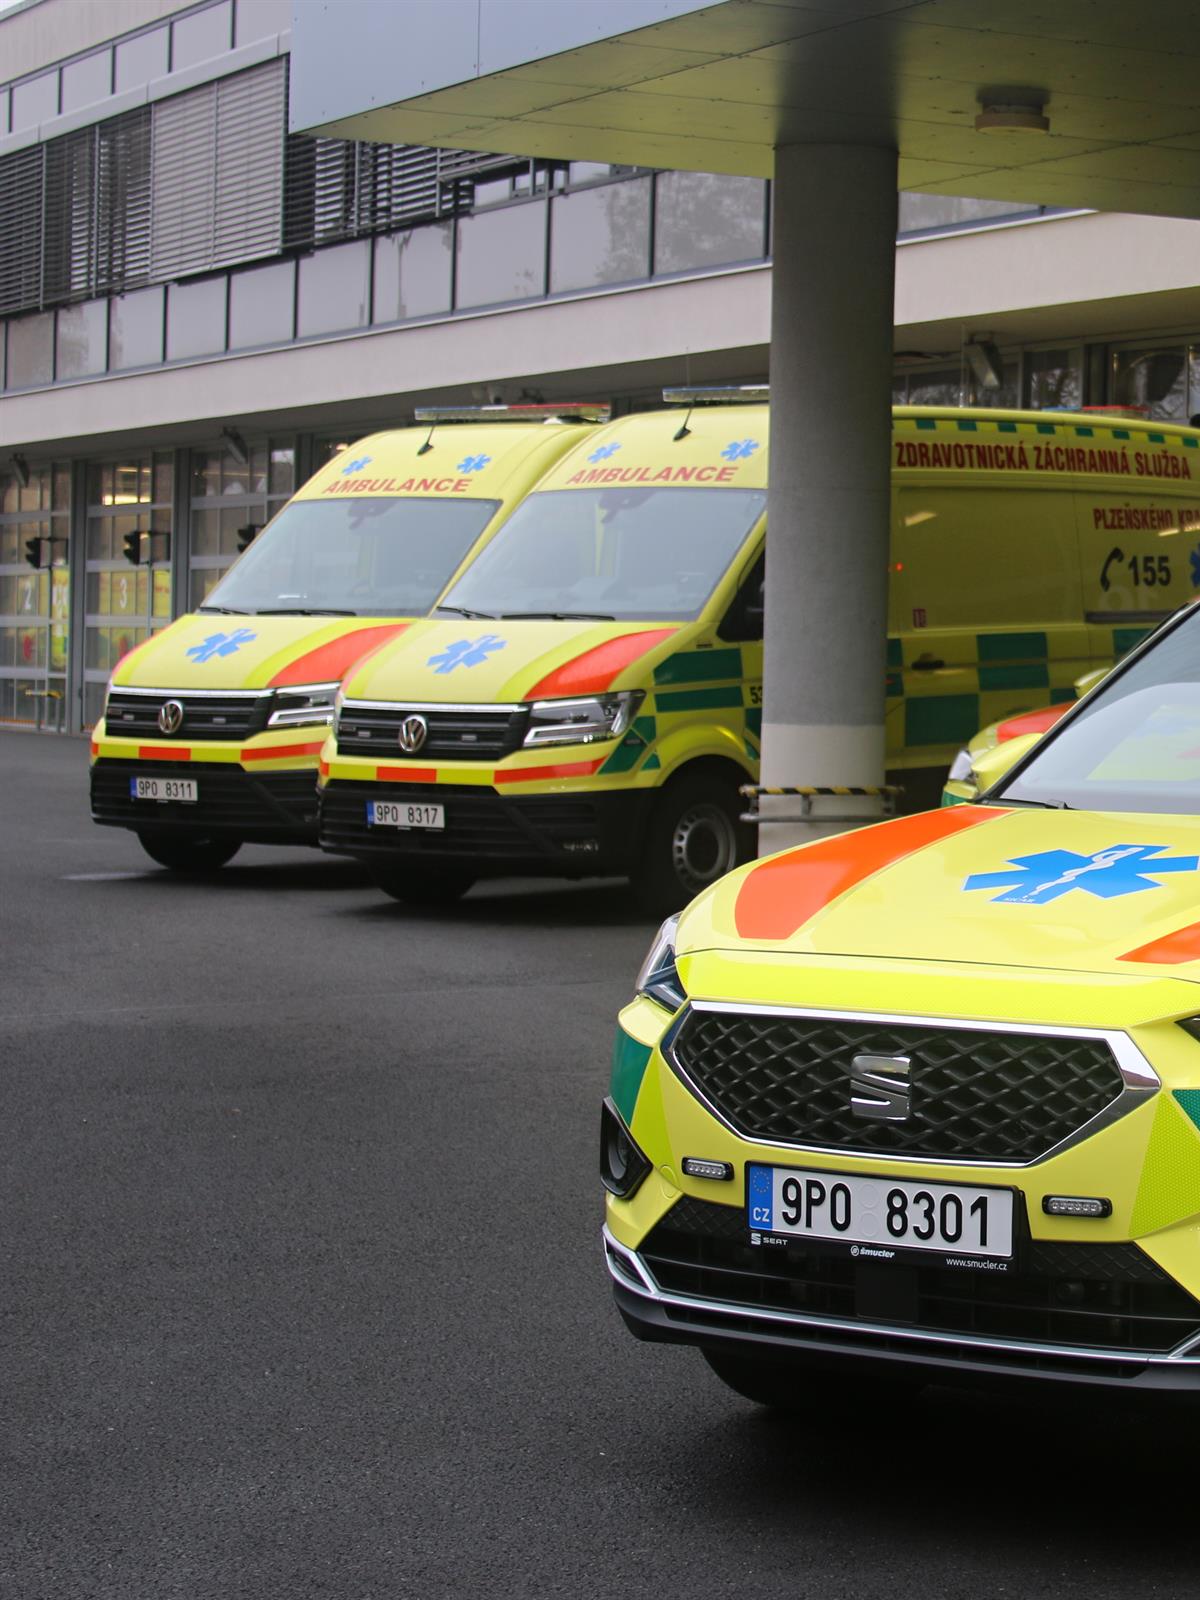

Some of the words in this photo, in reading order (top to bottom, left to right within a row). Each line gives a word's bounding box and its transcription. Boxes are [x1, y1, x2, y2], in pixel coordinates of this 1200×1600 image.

[895, 440, 1028, 469] ZDRAVOTNICKÁ
[1033, 441, 1130, 475] ZÁCHRANNÁ
[1135, 449, 1192, 480] SLUŽBA
[565, 466, 739, 485] AMBULANCE
[322, 478, 473, 495] AMBULANCE
[1128, 555, 1171, 587] 155
[165, 782, 193, 798] 8311
[407, 806, 439, 824] 8317
[753, 1206, 770, 1222] CZ
[886, 1187, 989, 1247] 8301
[763, 1237, 788, 1246] SEAT
[946, 1258, 1008, 1271] www.smucler.cz
